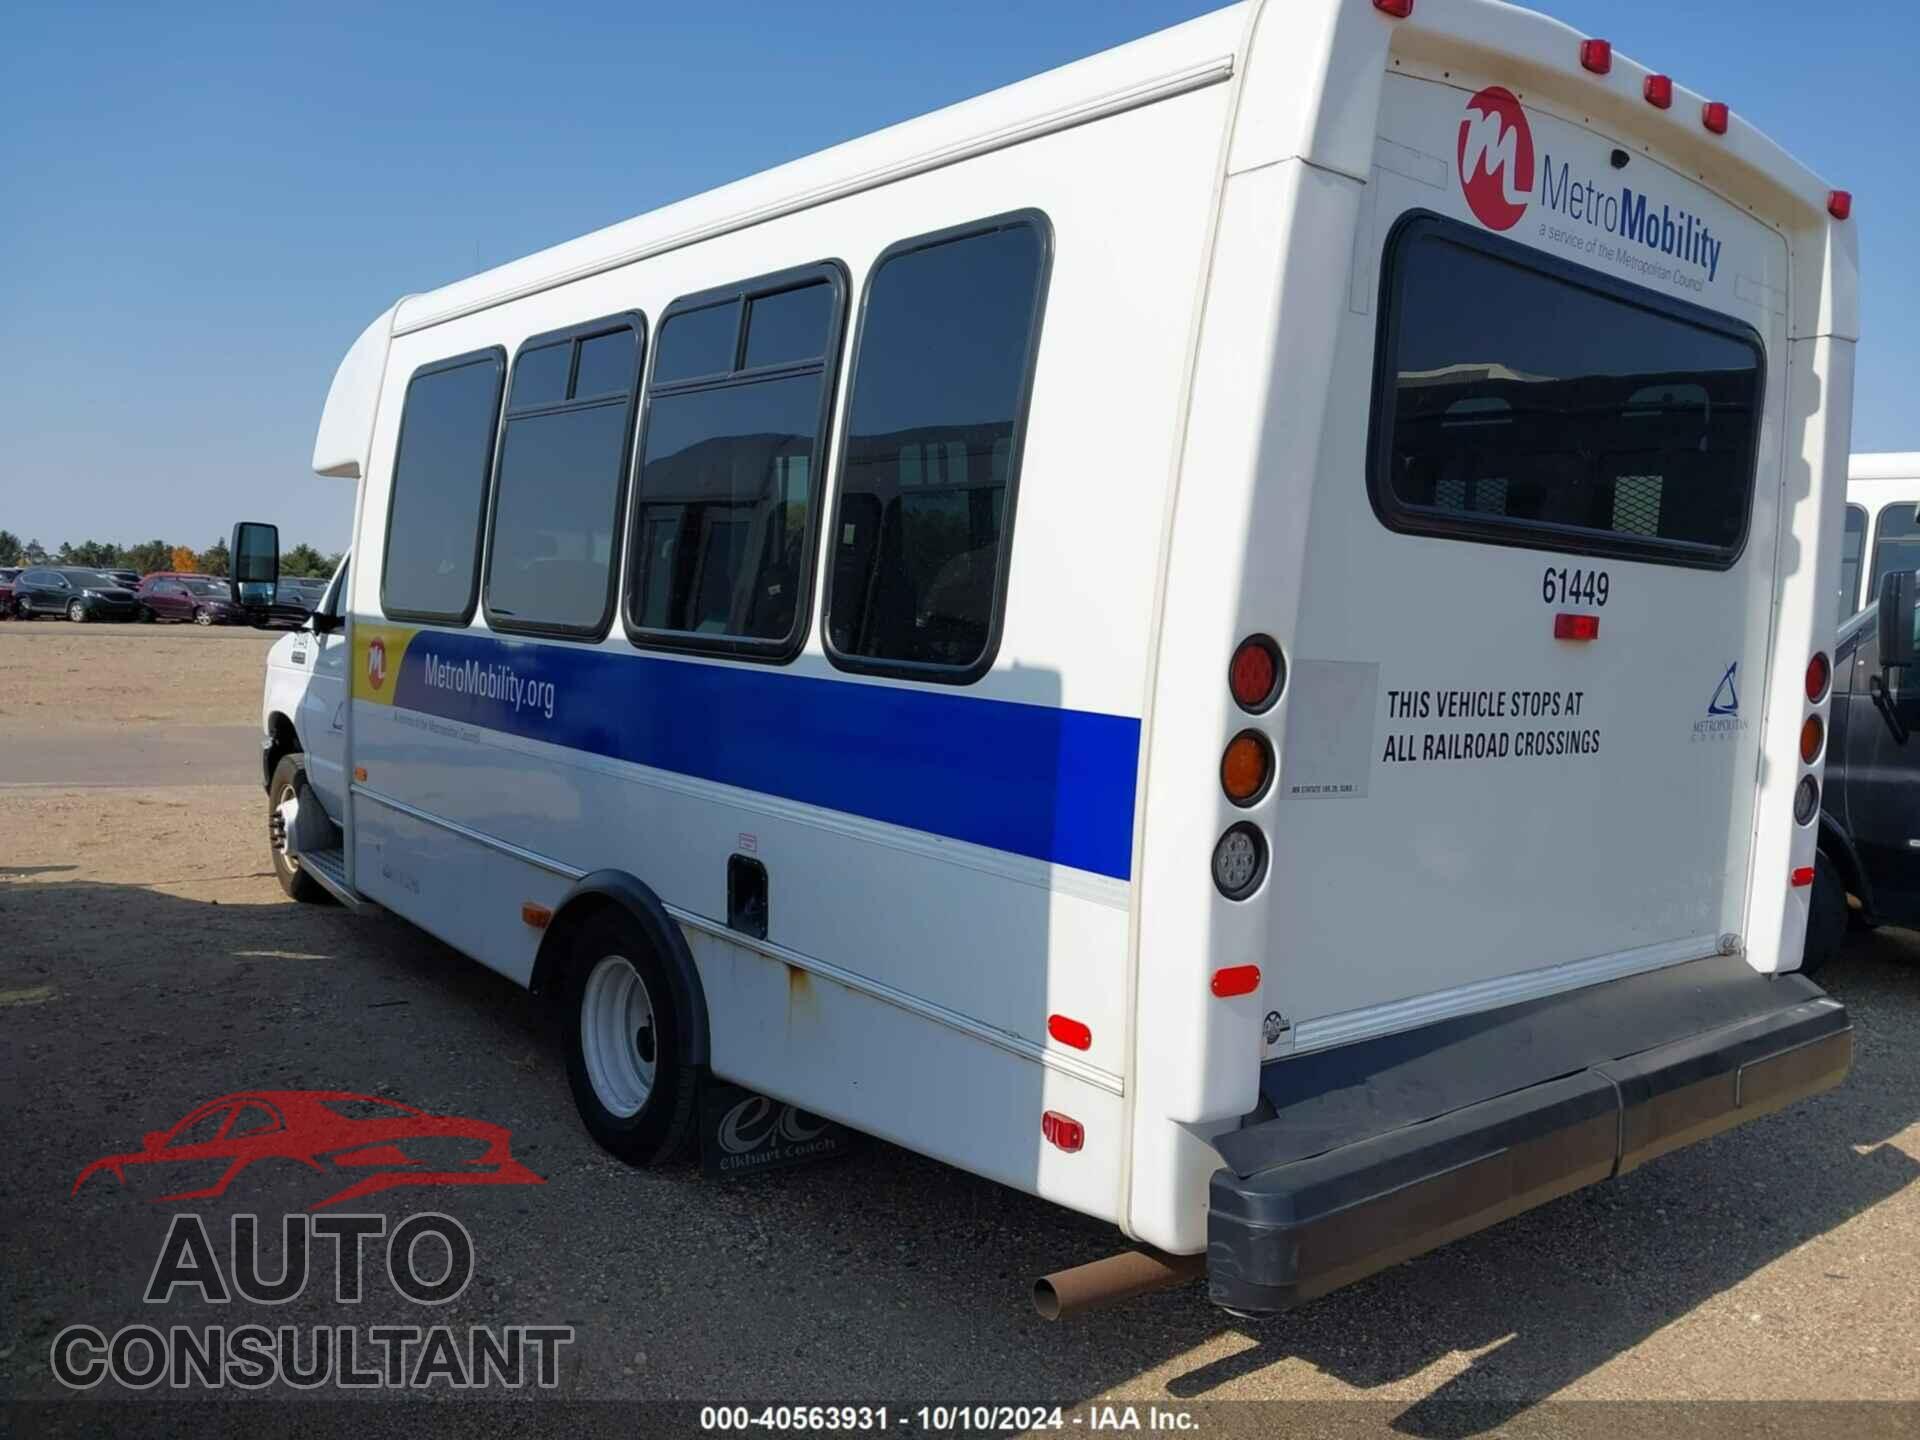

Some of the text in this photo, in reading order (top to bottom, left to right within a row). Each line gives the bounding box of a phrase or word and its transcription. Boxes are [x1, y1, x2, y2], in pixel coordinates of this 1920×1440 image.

[1540, 154, 1722, 281] MetroMobility
[1538, 223, 1706, 293] a service of the Metropolitan Council
[1542, 567, 1609, 607] 61449
[424, 652, 555, 719] MetroMobility.org
[1387, 690, 1584, 718] THIS VEHICLE STOPS AT
[1382, 729, 1600, 762] ALL RAILROAD CROSSINGS
